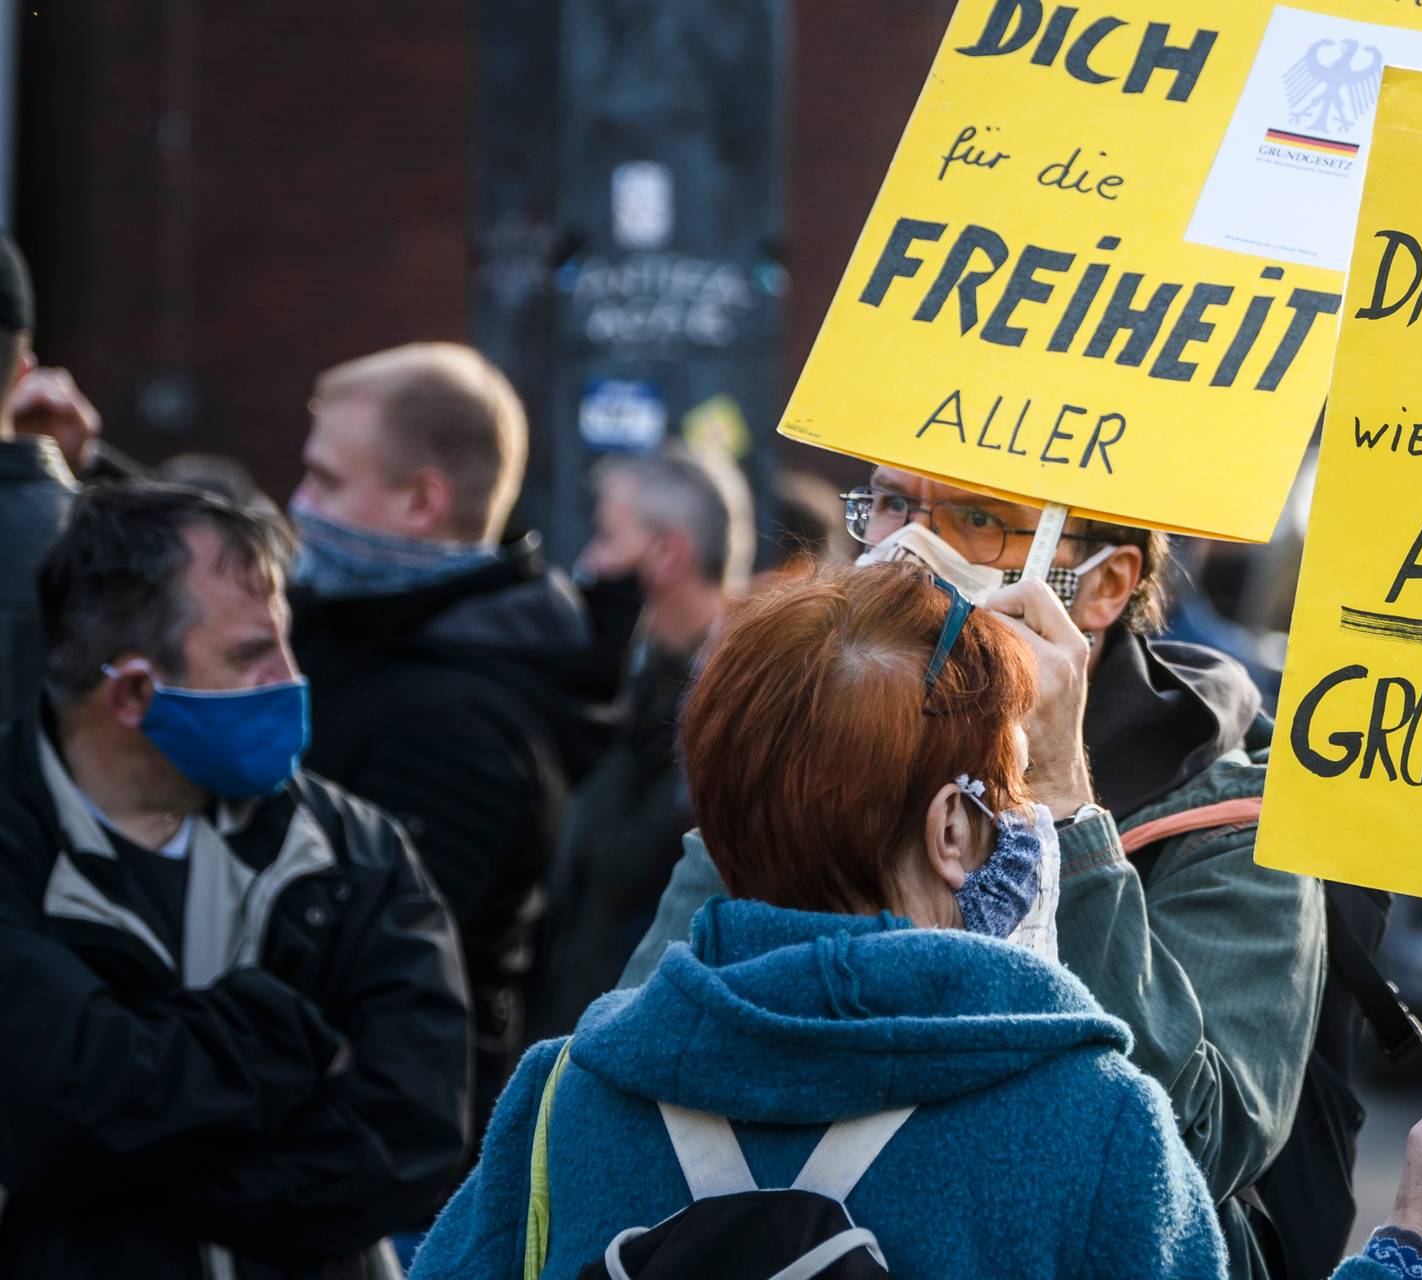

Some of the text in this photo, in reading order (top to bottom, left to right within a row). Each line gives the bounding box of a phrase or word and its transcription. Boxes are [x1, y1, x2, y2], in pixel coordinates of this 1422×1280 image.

[956, 0, 1219, 103] DICH
[939, 126, 1124, 201] für die
[1258, 145, 1353, 171] GRUNDGESETZ
[916, 390, 1126, 474] ALLER
